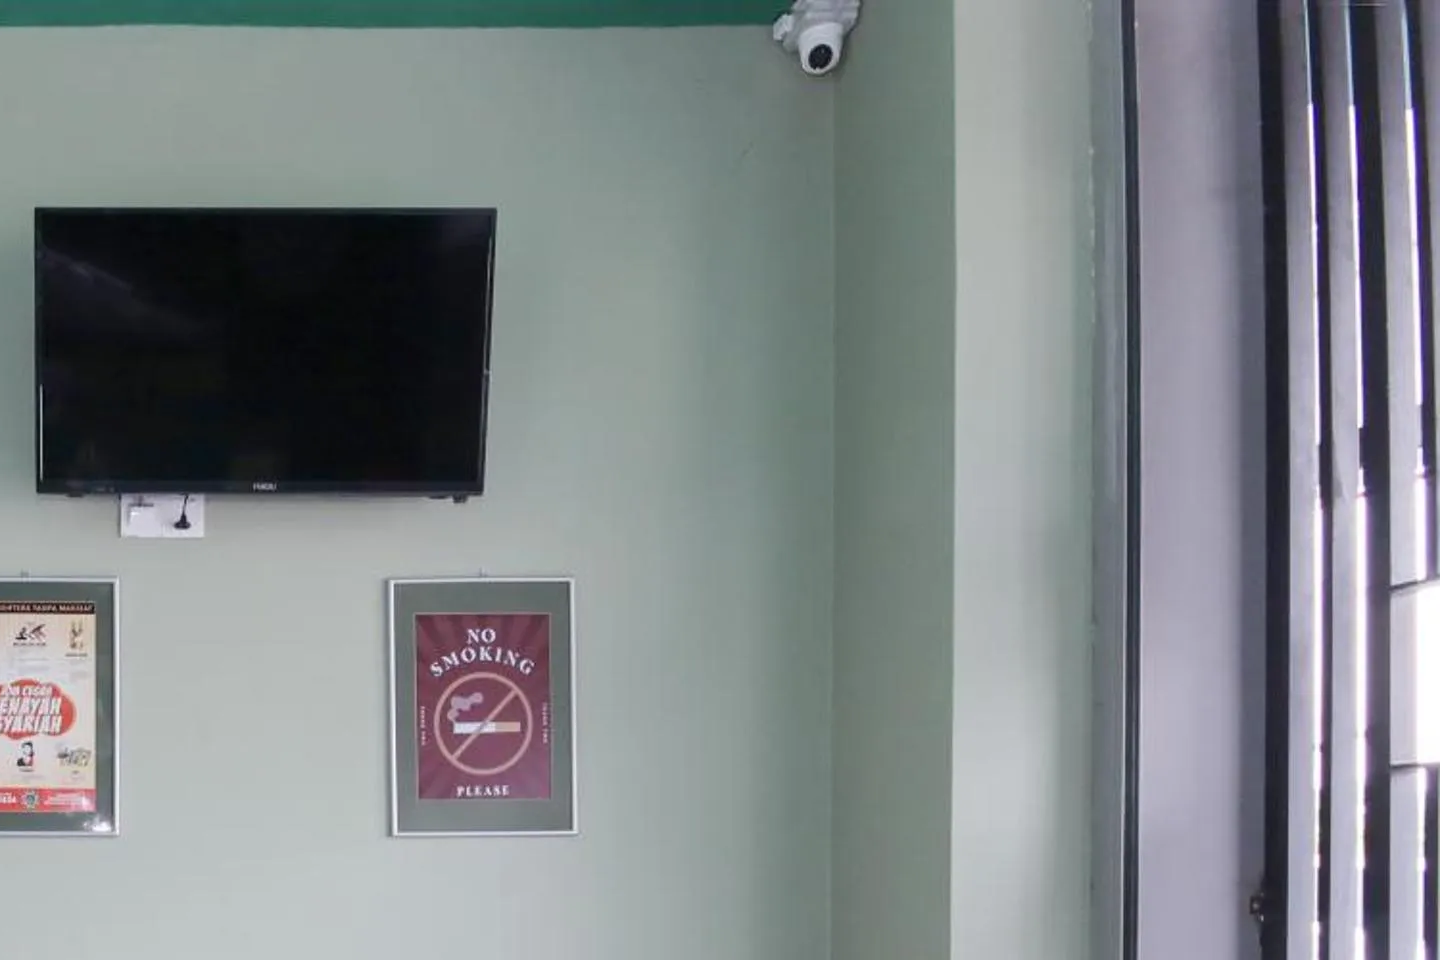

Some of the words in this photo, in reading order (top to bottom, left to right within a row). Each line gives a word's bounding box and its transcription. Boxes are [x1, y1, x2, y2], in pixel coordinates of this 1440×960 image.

[467, 628, 497, 645] NO
[429, 645, 536, 678] SMOKING
[456, 785, 510, 797] PLEASE
